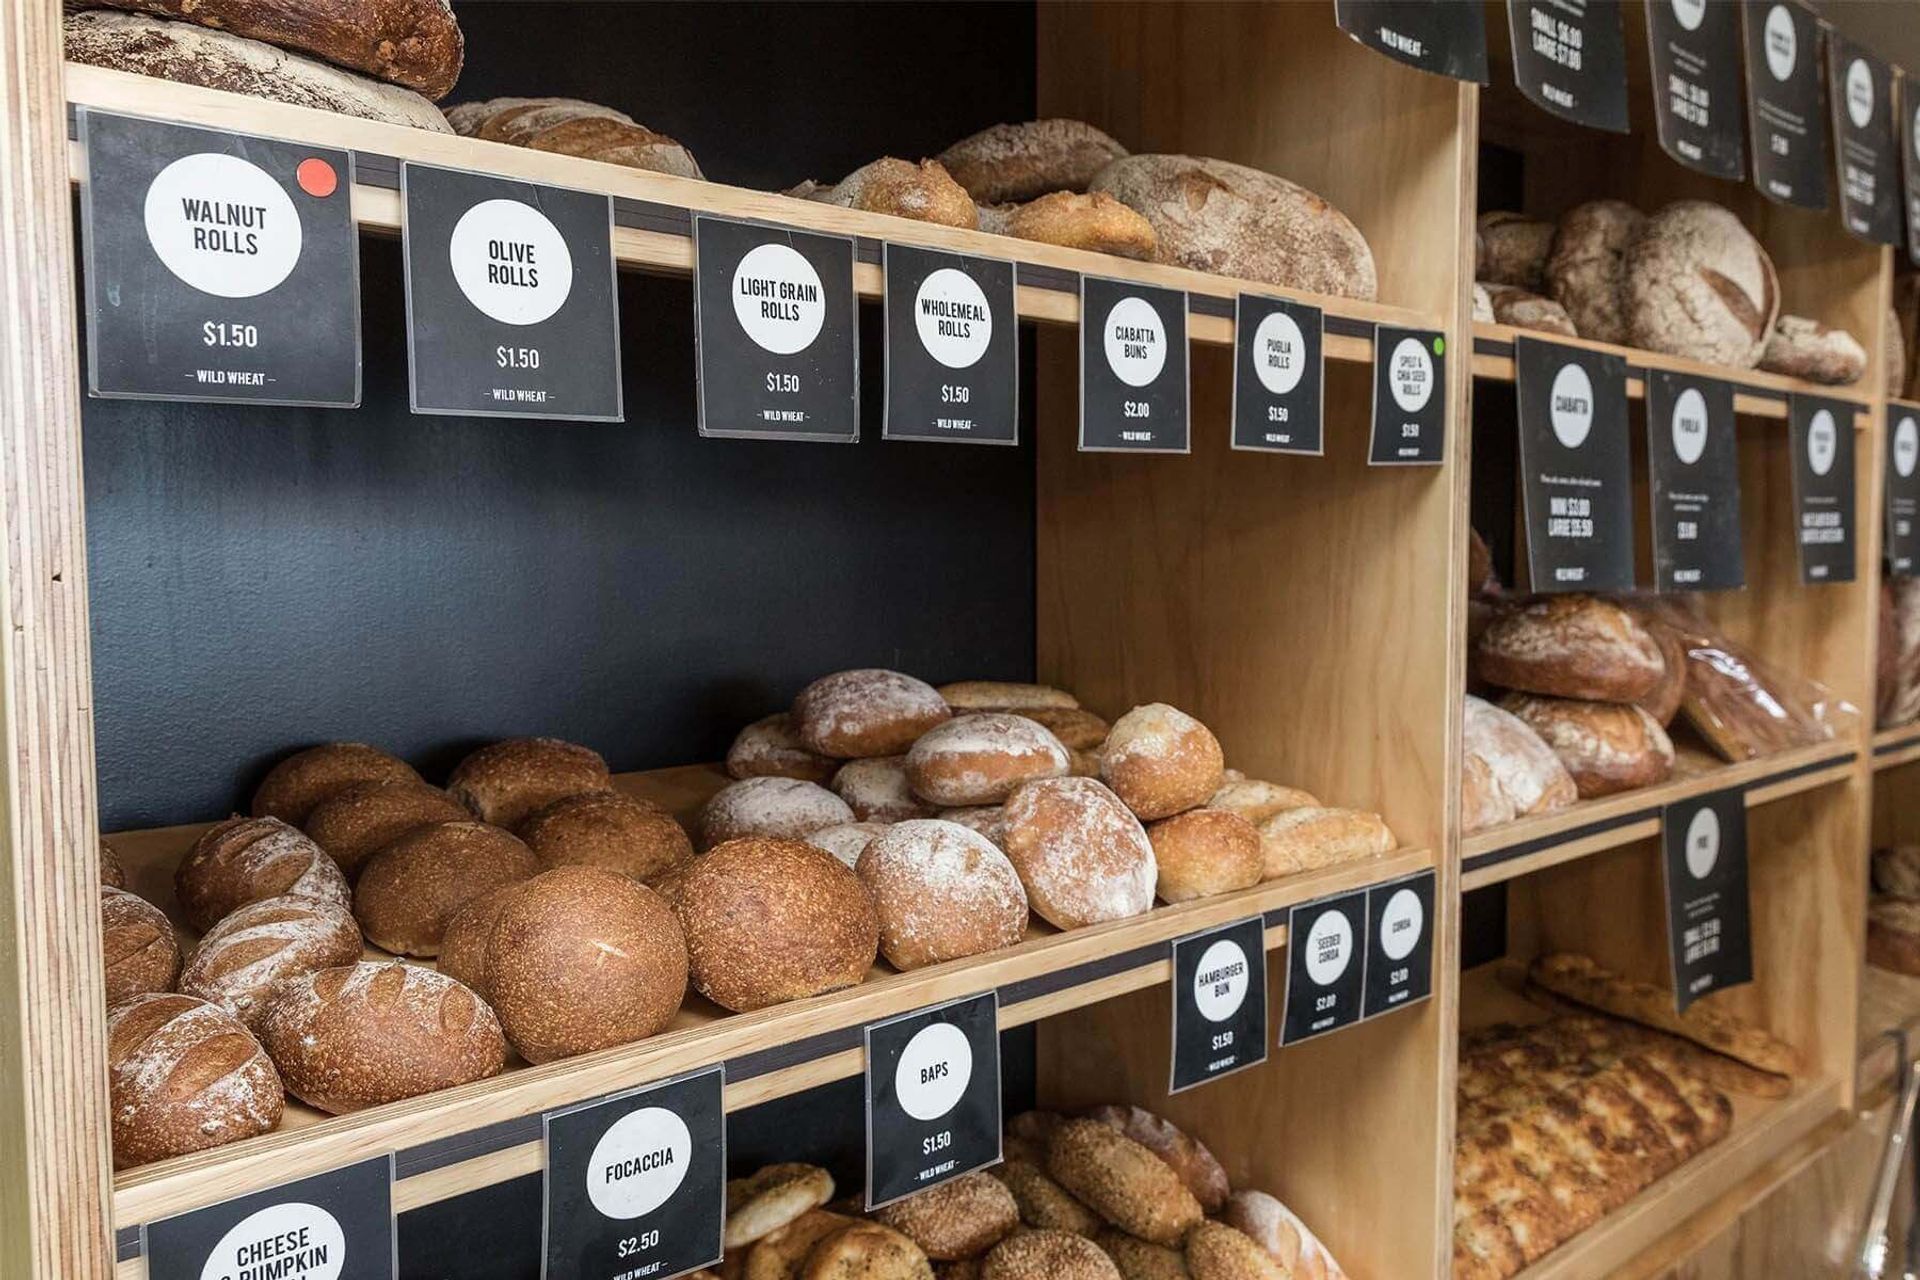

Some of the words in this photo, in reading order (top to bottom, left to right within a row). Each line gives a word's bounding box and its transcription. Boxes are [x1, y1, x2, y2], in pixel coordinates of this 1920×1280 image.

[182, 197, 267, 230] WALNUT
[194, 227, 259, 255] ROLLS
[488, 240, 536, 264] OLIVE
[488, 263, 539, 288] ROLLS
[740, 276, 777, 297] LIGHT
[779, 281, 818, 303] GRAIN
[760, 300, 800, 321] ROLLS
[921, 298, 986, 322] WHOLEMEAL
[203, 321, 258, 348] $1.50
[938, 319, 971, 339] ROLLS
[1115, 326, 1155, 344] CIABATTA
[1124, 343, 1148, 360] BUNS
[1267, 338, 1292, 354] PUGLIA
[497, 345, 540, 369] $1.50
[1268, 354, 1290, 370] ROLLS
[197, 369, 225, 384] WILD
[227, 371, 265, 386] WHEAT
[767, 372, 800, 392] $1.50
[492, 388, 515, 401] WILD
[517, 390, 547, 402] WHEAT
[941, 385, 970, 403] $1.50
[763, 409, 781, 421] WILD
[782, 411, 805, 422] WHEAT
[1124, 400, 1149, 417] $2.00
[1268, 406, 1289, 422] $1.50
[937, 418, 951, 428] WILD
[952, 419, 971, 430] WHEAT
[1122, 431, 1135, 441] WILD
[1135, 431, 1151, 441] WHEAT
[1199, 961, 1244, 987] HAMBURGER
[1214, 982, 1230, 998] BUN
[1212, 1031, 1234, 1050] $1.50
[920, 1061, 949, 1085] BAPS
[923, 1131, 951, 1155] $1.50
[605, 1147, 674, 1184] FOCACCIA
[920, 1167, 935, 1181] WILD
[935, 1159, 956, 1175] WHEAT
[236, 1226, 310, 1267] CHEESE
[618, 1229, 660, 1258] $2.50
[634, 1261, 661, 1278] WHEAT
